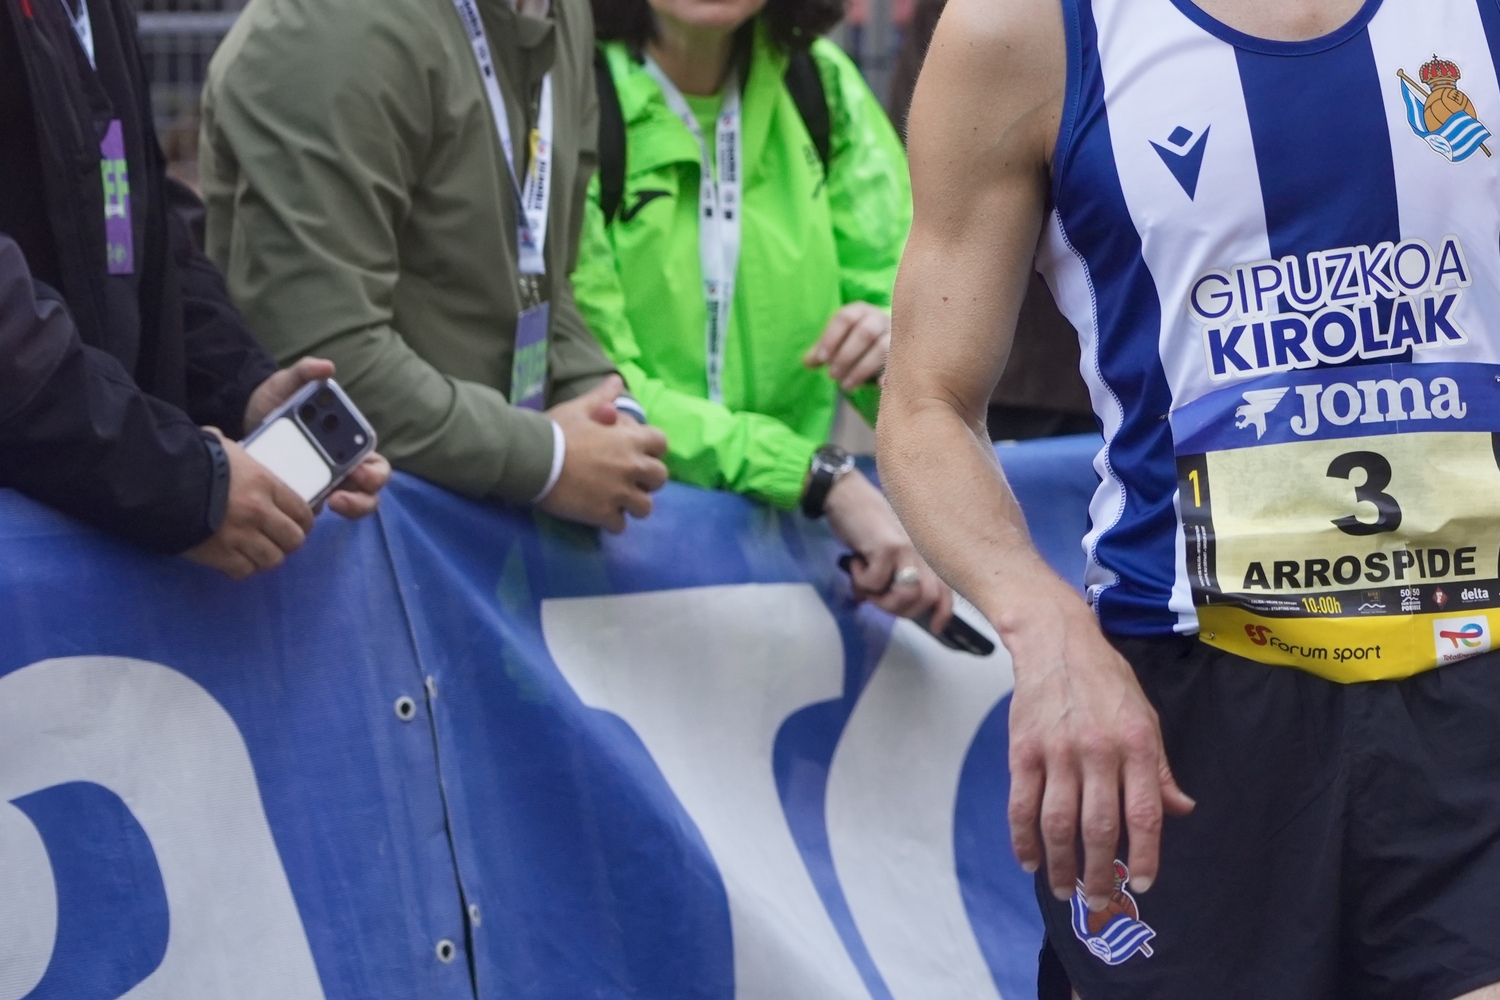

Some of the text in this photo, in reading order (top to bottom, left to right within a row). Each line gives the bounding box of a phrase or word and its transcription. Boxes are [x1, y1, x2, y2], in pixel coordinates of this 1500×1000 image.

[1190, 239, 1467, 316] GIPUZKOA
[1208, 294, 1462, 375] KIROLAK
[1289, 377, 1467, 436] Joma
[1188, 469, 1201, 508] 1
[1325, 450, 1403, 536] 3
[1242, 546, 1477, 589] ARROSPIDE
[1302, 596, 1342, 614] 10:00h
[1461, 587, 1489, 601] delta
[1333, 645, 1381, 663] sport
